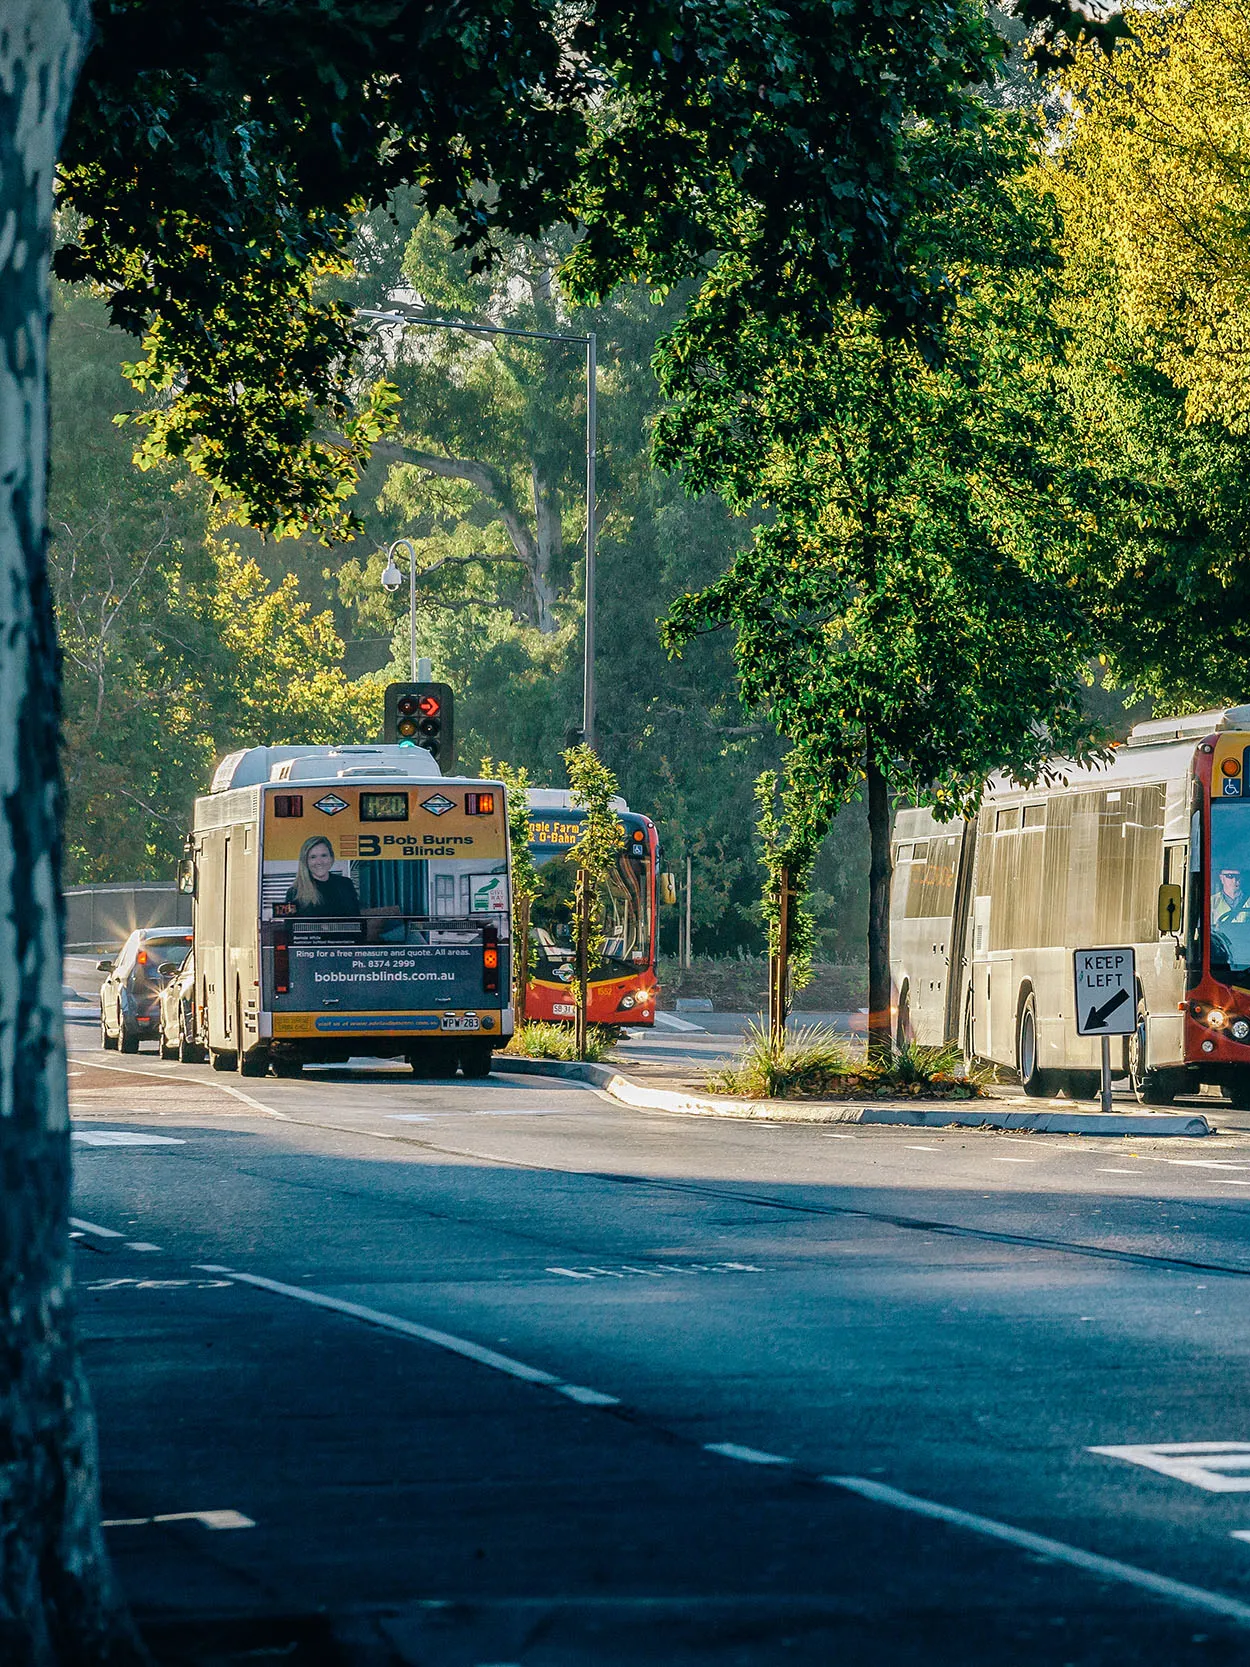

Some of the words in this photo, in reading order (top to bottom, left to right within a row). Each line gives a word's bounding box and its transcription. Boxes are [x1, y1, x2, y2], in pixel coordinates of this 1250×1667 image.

[554, 822, 579, 833] Farm
[383, 835, 416, 845] Bob
[423, 835, 473, 845] Burns
[539, 832, 576, 843] O-Bahn
[403, 846, 455, 856] Blinds
[296, 950, 314, 959] Ring
[390, 949, 405, 957] and
[407, 949, 433, 958] quote.
[352, 960, 366, 968] Ph.
[368, 960, 390, 968] 8374
[1085, 956, 1124, 969] KEEP
[314, 972, 455, 982] bobburnsblinds.com.au
[1087, 974, 1123, 987] LEFT
[442, 1018, 460, 1028] WPW
[463, 1018, 478, 1028] 283
